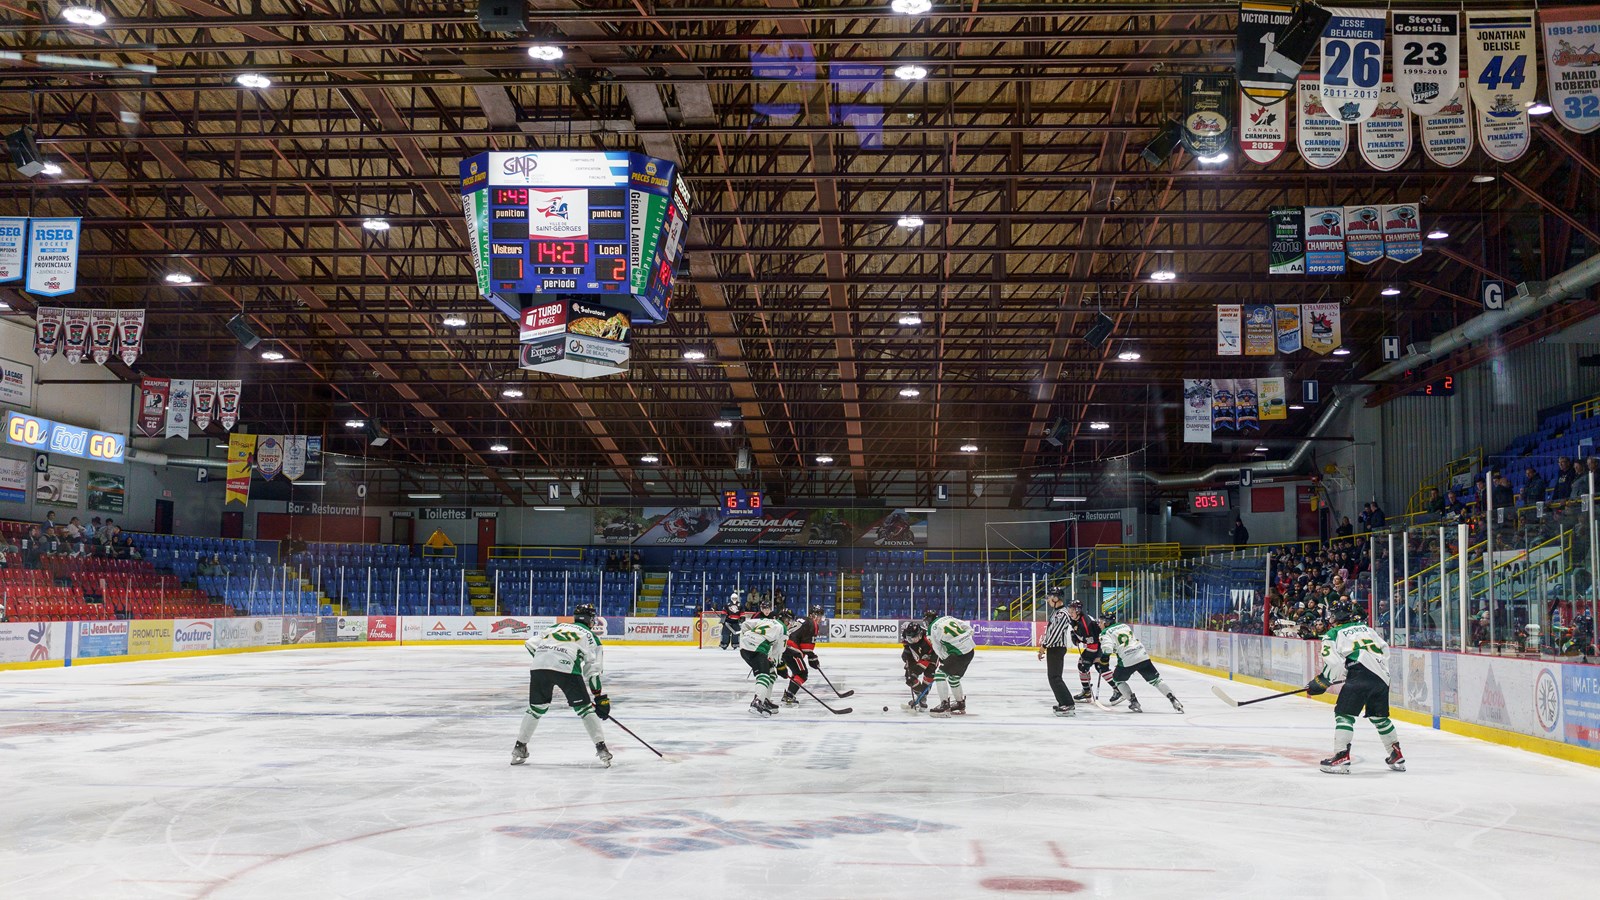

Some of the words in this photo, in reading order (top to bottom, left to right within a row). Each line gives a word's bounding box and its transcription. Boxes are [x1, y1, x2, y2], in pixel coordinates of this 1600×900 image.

[1241, 13, 1268, 24] VICTOR
[1339, 20, 1365, 28] JESSE
[1408, 15, 1442, 24] Steve
[1330, 29, 1374, 39] BELANGER
[1395, 23, 1450, 34] Gosselin
[1477, 30, 1526, 41] JONATHAN
[1483, 41, 1521, 51] DELISLE
[1403, 42, 1448, 66] 23
[1323, 40, 1381, 88] 26
[1477, 55, 1528, 90] 44
[1561, 70, 1597, 81] MARIO
[1323, 88, 1378, 99] 2011-2013
[1563, 95, 1600, 119] 32
[1429, 138, 1466, 146] CHAMPION
[1487, 133, 1524, 141] FINALISTE
[631, 172, 649, 183] PIÈCES
[650, 177, 669, 187] D'AUTO
[498, 189, 528, 206] 1:43
[496, 210, 525, 219] punition
[592, 210, 622, 219] punition
[630, 192, 640, 226] GÉRALD
[35, 229, 74, 241] RSEQ
[643, 196, 667, 269] PHARMACIEN
[1385, 233, 1420, 242] CHAMPIONS
[492, 243, 523, 255] Visiteurs
[599, 244, 623, 255] Local
[630, 227, 640, 268] LAMBERT
[1272, 241, 1302, 253] 2019
[1307, 241, 1344, 251] CHAMPIONS
[538, 242, 589, 264] 14:21
[519, 259, 523, 279] 1
[613, 258, 626, 280] 2
[1290, 264, 1303, 272] AA
[543, 279, 575, 290] periode
[1484, 283, 1503, 310] G
[537, 303, 563, 318] TURBO
[538, 316, 555, 327] IMAGES
[530, 345, 557, 360] Express
[592, 350, 609, 358] BEAUCE
[1384, 338, 1398, 359] H
[1444, 377, 1453, 389] 2
[1426, 384, 1433, 395] 2
[9, 415, 38, 445] GO
[50, 424, 88, 455] Cool
[89, 434, 116, 460] GO
[36, 455, 47, 471] Q
[197, 467, 207, 482] P
[1241, 470, 1251, 486] J
[549, 483, 558, 499] N
[938, 485, 946, 499] L
[727, 496, 737, 508] 16
[750, 496, 760, 508] 13
[1195, 495, 1225, 508] 20:51
[288, 502, 304, 514] Bar
[311, 504, 360, 516] Restaurant
[425, 508, 467, 520] Toilettes
[1085, 510, 1121, 521] Restaurant
[722, 518, 805, 527] ADRENALINE
[90, 623, 107, 635] Jean
[375, 619, 387, 629] Tim
[635, 625, 669, 634] CENTRE
[670, 625, 690, 634] HI-FI
[132, 628, 171, 639] PROMUTUEL
[174, 628, 212, 642] Couture
[369, 629, 393, 640] Hortons
[849, 626, 897, 635] ESTAMPRO
